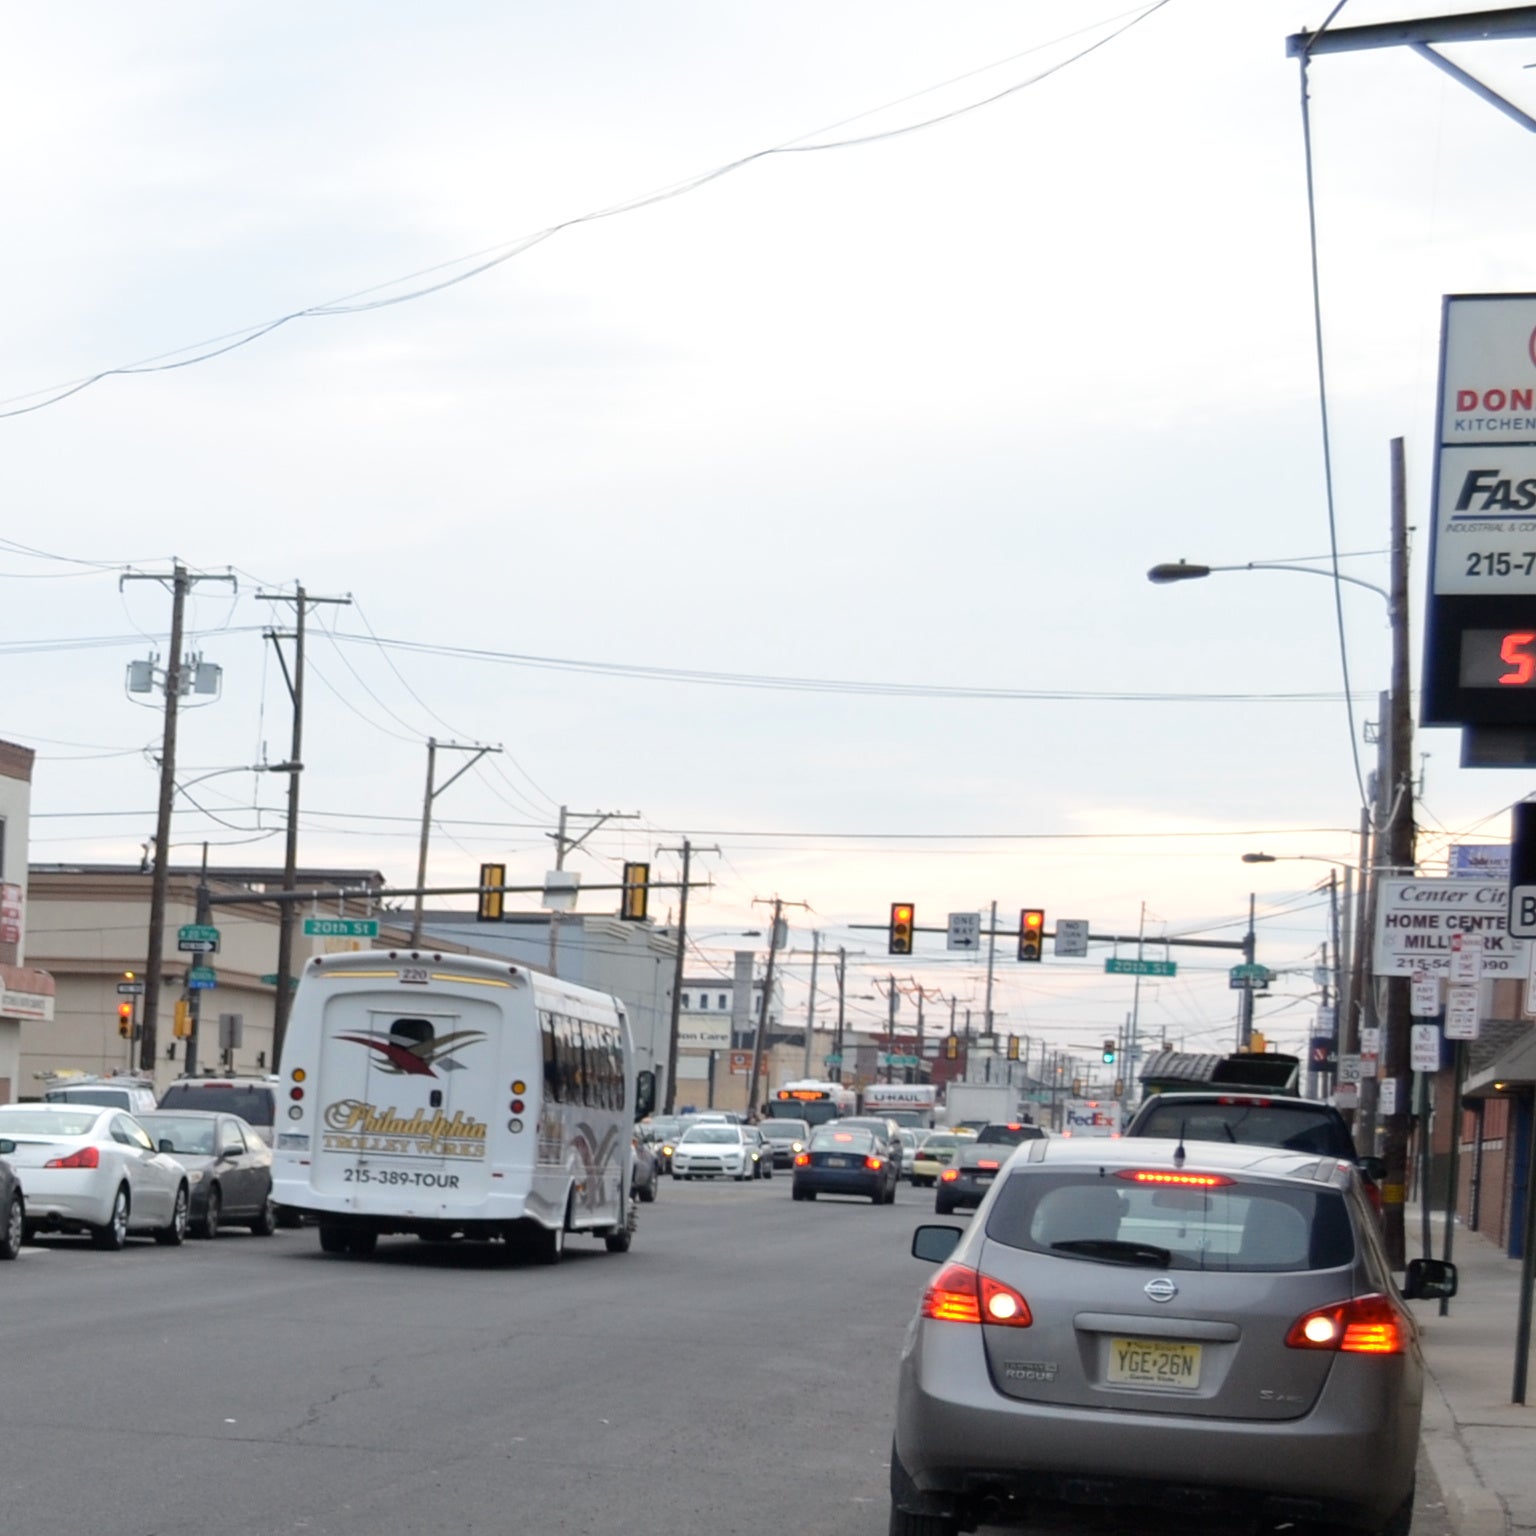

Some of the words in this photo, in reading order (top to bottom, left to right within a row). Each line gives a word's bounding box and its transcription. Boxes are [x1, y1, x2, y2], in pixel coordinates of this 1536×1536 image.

[1446, 523, 1505, 532] INDUSTRIAL
[1508, 523, 1516, 532] &
[1399, 884, 1469, 903] Center
[312, 920, 349, 934] 20th
[353, 920, 370, 935] St
[953, 916, 975, 926] ONE
[1065, 922, 1079, 930] NO
[1385, 914, 1441, 930] HOME
[952, 926, 975, 936] WAY
[402, 969, 428, 980] 220
[1114, 961, 1148, 974] 20th
[1152, 962, 1169, 975] St
[699, 1032, 729, 1041] Care
[1342, 1070, 1360, 1080] 30
[324, 1098, 487, 1140] Philadelphia
[1067, 1109, 1115, 1127] FedEx
[322, 1134, 412, 1154] TROLLEY
[414, 1139, 486, 1158] WORKS
[343, 1168, 460, 1189] 215-389-TOUR
[1005, 1369, 1056, 1382] ROGUE
[1129, 1373, 1154, 1381] Garden
